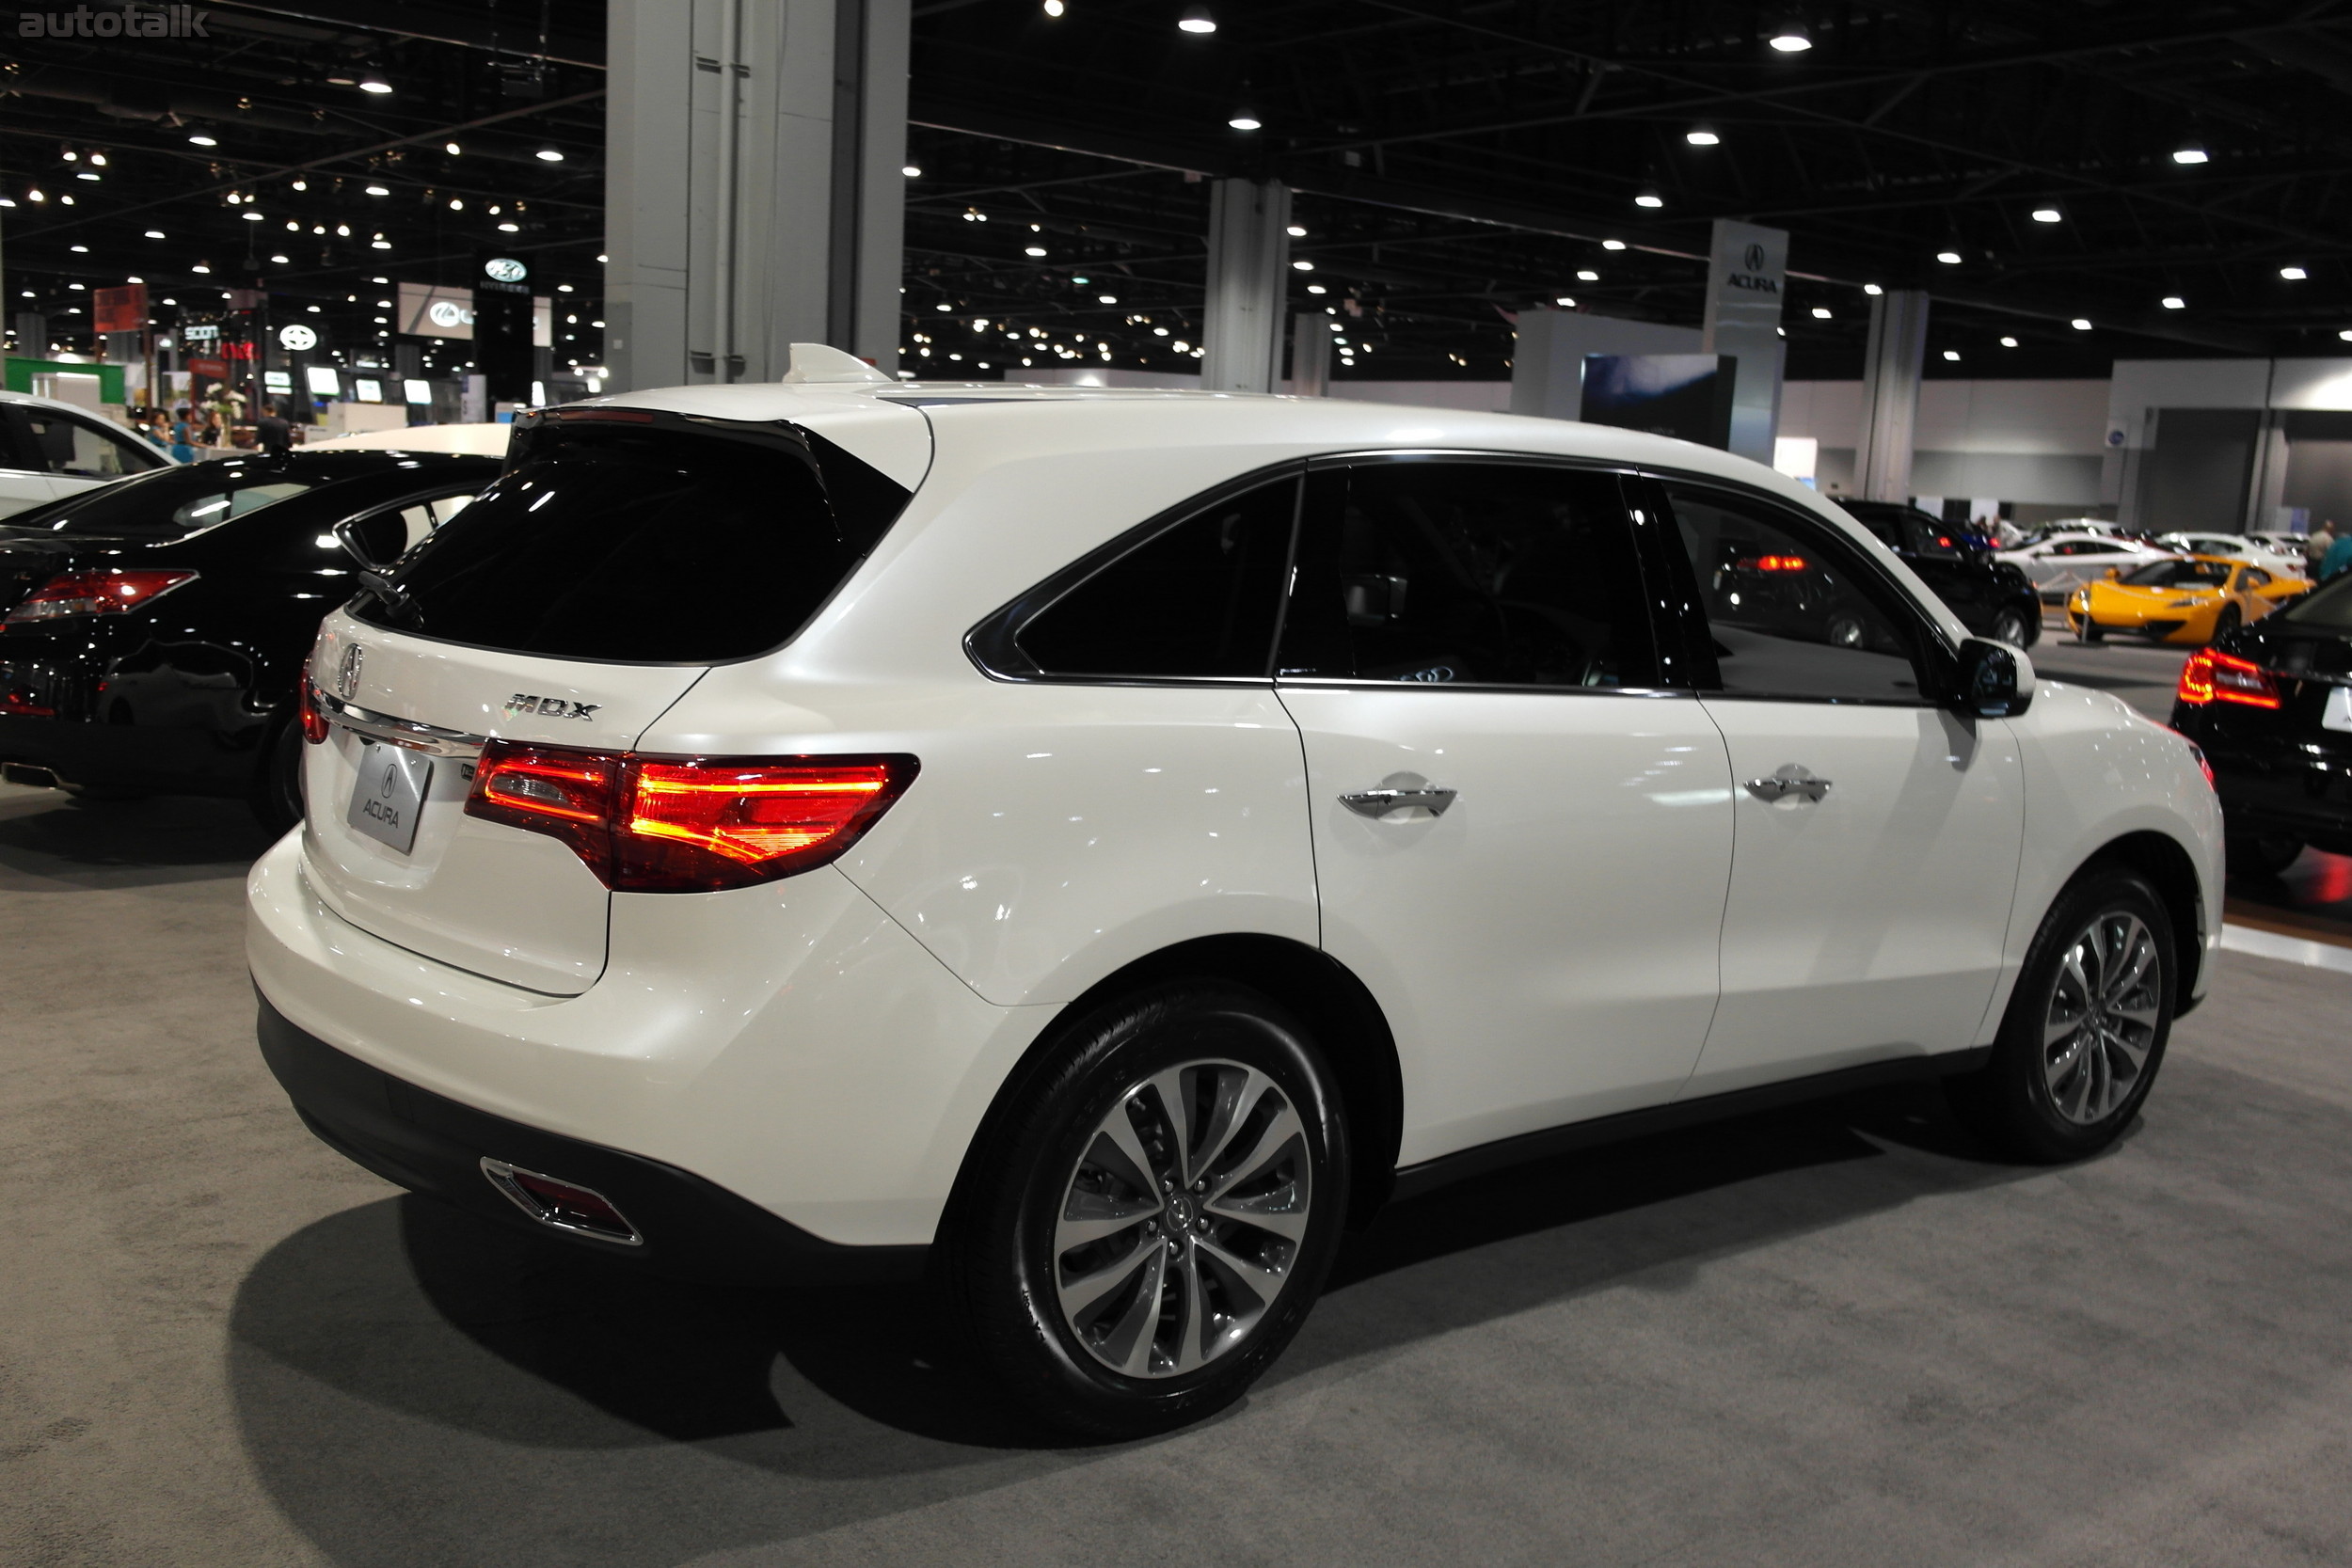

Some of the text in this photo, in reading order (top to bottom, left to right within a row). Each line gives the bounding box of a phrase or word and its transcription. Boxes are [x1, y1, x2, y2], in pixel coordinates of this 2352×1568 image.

[1727, 274, 1777, 293] ACURA
[505, 693, 602, 722] MDX
[363, 799, 399, 829] ACURA
